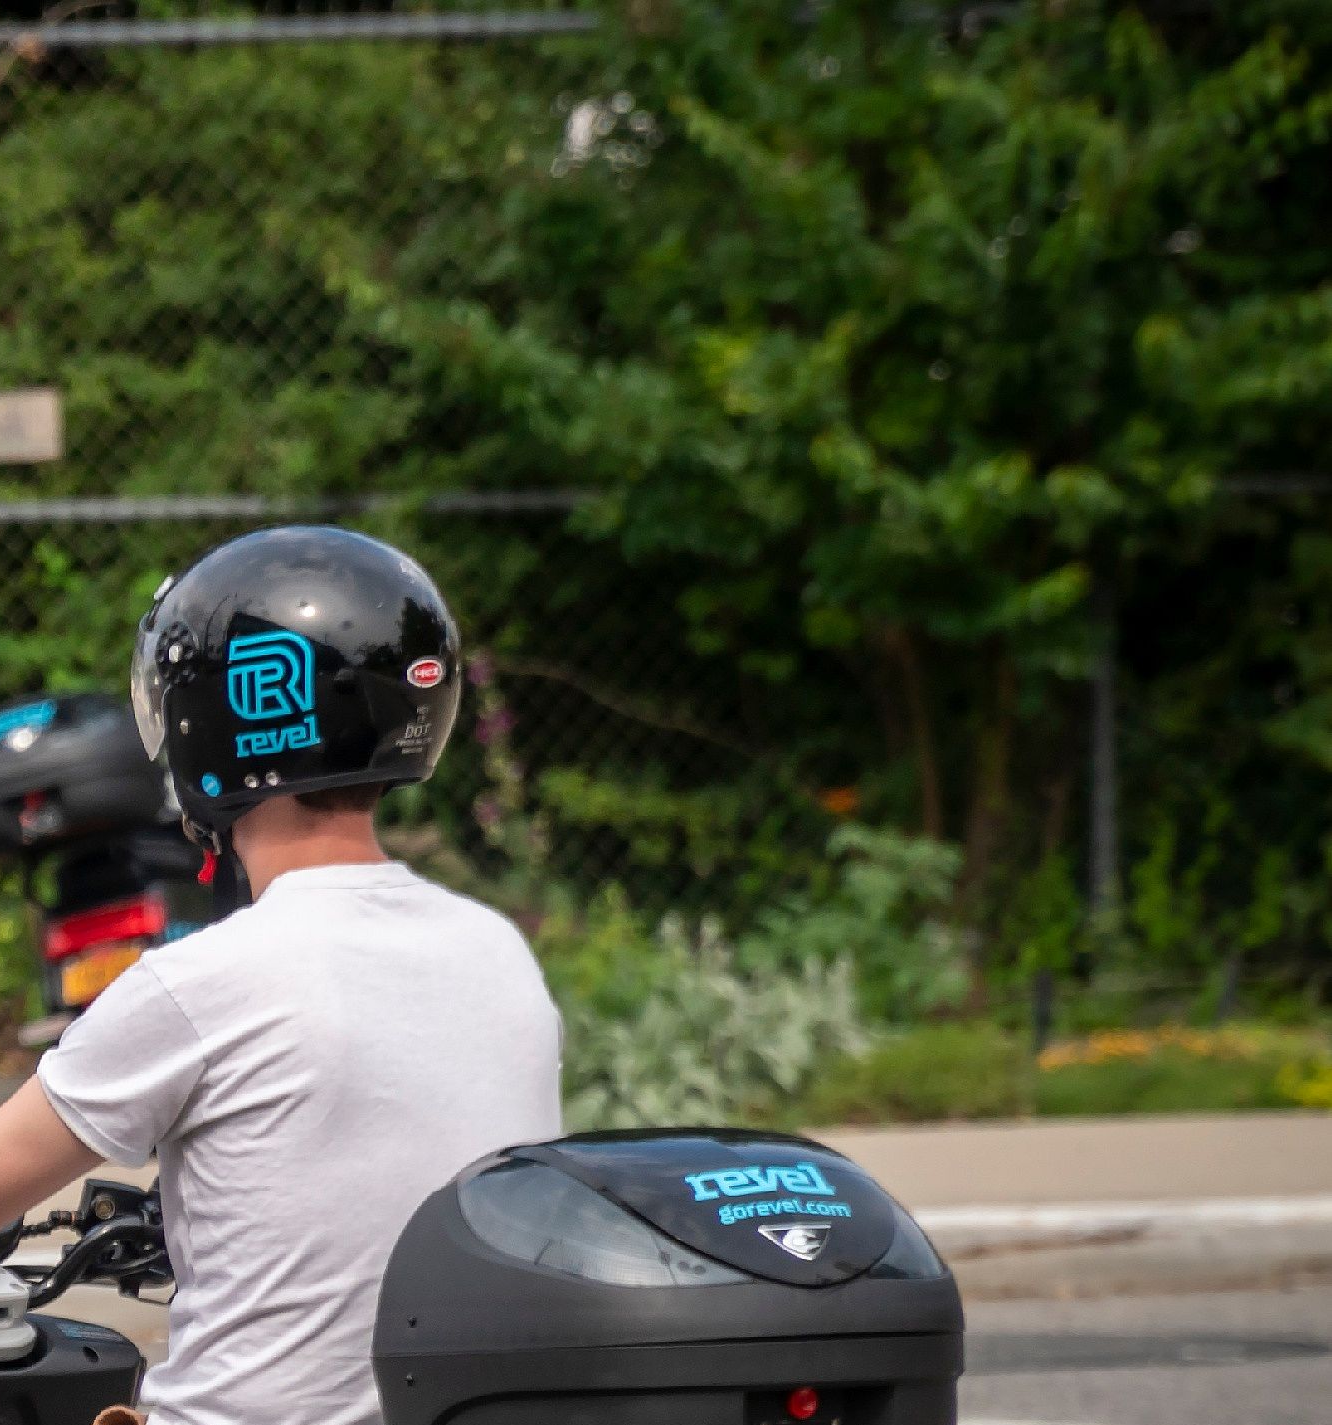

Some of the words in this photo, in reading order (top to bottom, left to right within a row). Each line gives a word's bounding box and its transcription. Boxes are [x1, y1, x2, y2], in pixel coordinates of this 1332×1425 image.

[235, 714, 321, 758] revel
[685, 1162, 836, 1201] revel
[718, 1197, 852, 1226] gorevel.com
